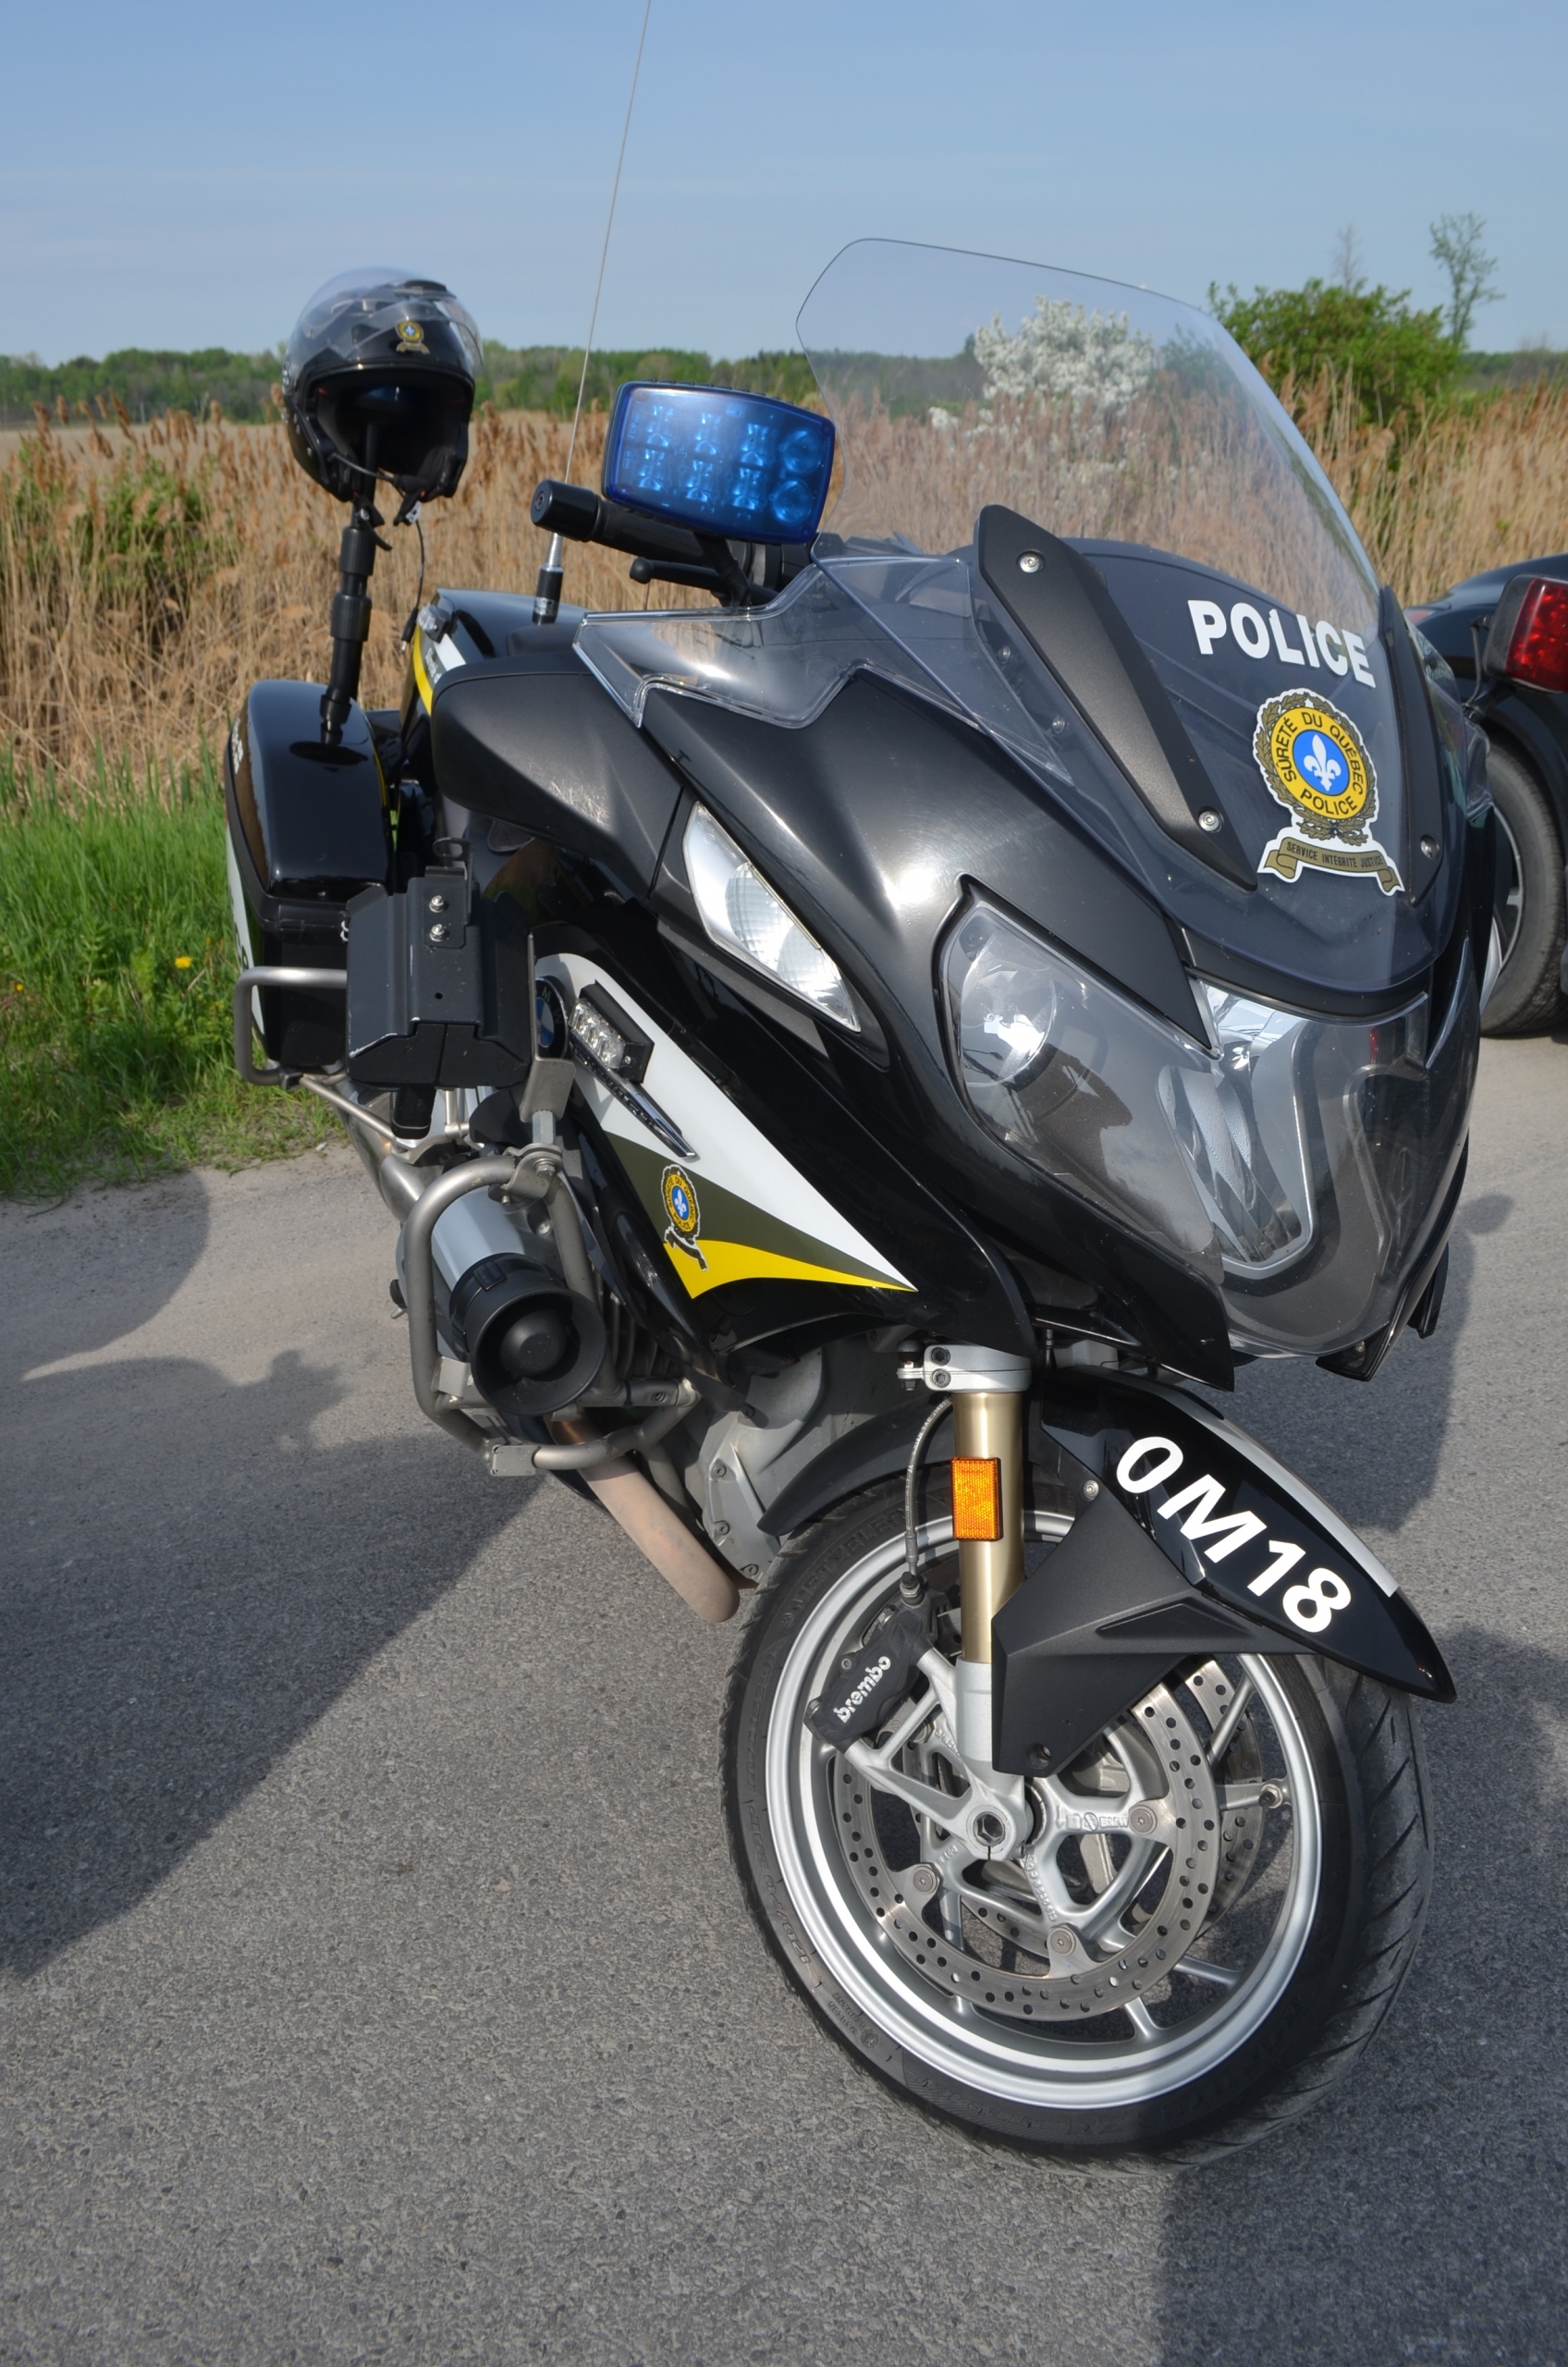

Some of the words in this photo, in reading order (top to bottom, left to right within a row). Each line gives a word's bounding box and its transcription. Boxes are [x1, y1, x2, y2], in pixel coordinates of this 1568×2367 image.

[1187, 599, 1376, 688] POLICE
[1276, 717, 1298, 782] SÛRETÉ
[1301, 711, 1322, 728] DU
[1329, 725, 1364, 795] QUÉBEC
[1300, 788, 1357, 816] POLICE
[1286, 841, 1317, 861] SERVICE
[1361, 854, 1384, 869] JUSTICE
[833, 1656, 891, 1723] brembo
[1099, 1817, 1128, 1829] BMW
